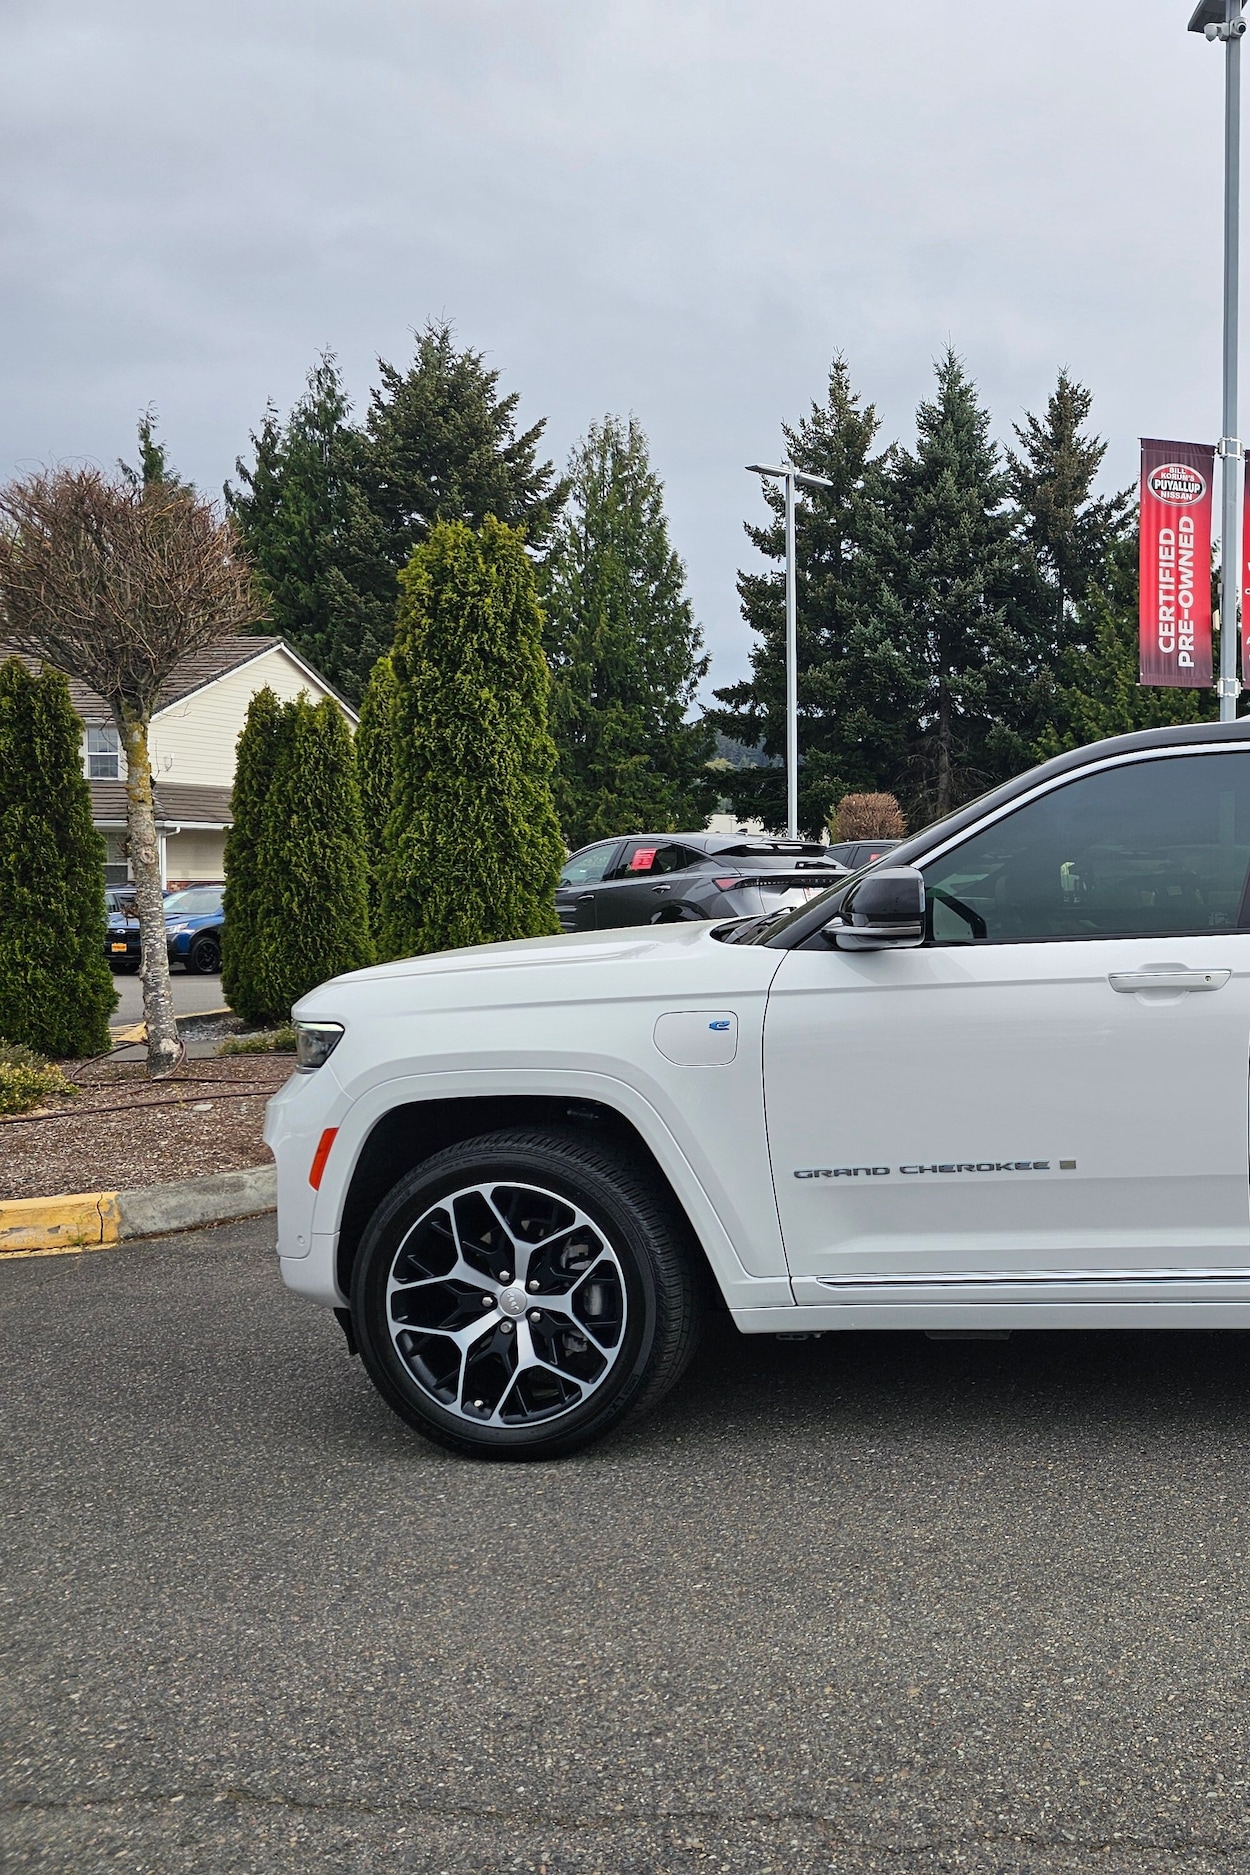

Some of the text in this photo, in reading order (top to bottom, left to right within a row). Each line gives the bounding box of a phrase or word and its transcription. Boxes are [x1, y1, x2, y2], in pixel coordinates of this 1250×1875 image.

[1161, 472, 1195, 481] KORUM'S
[1154, 479, 1200, 493] PUYALLUP
[1161, 491, 1192, 500] NISSAN
[1158, 527, 1176, 654] CERTIFIED
[1178, 515, 1195, 668] PRE-OWNED
[793, 1160, 1051, 1179] GRAND CHEROKEE
